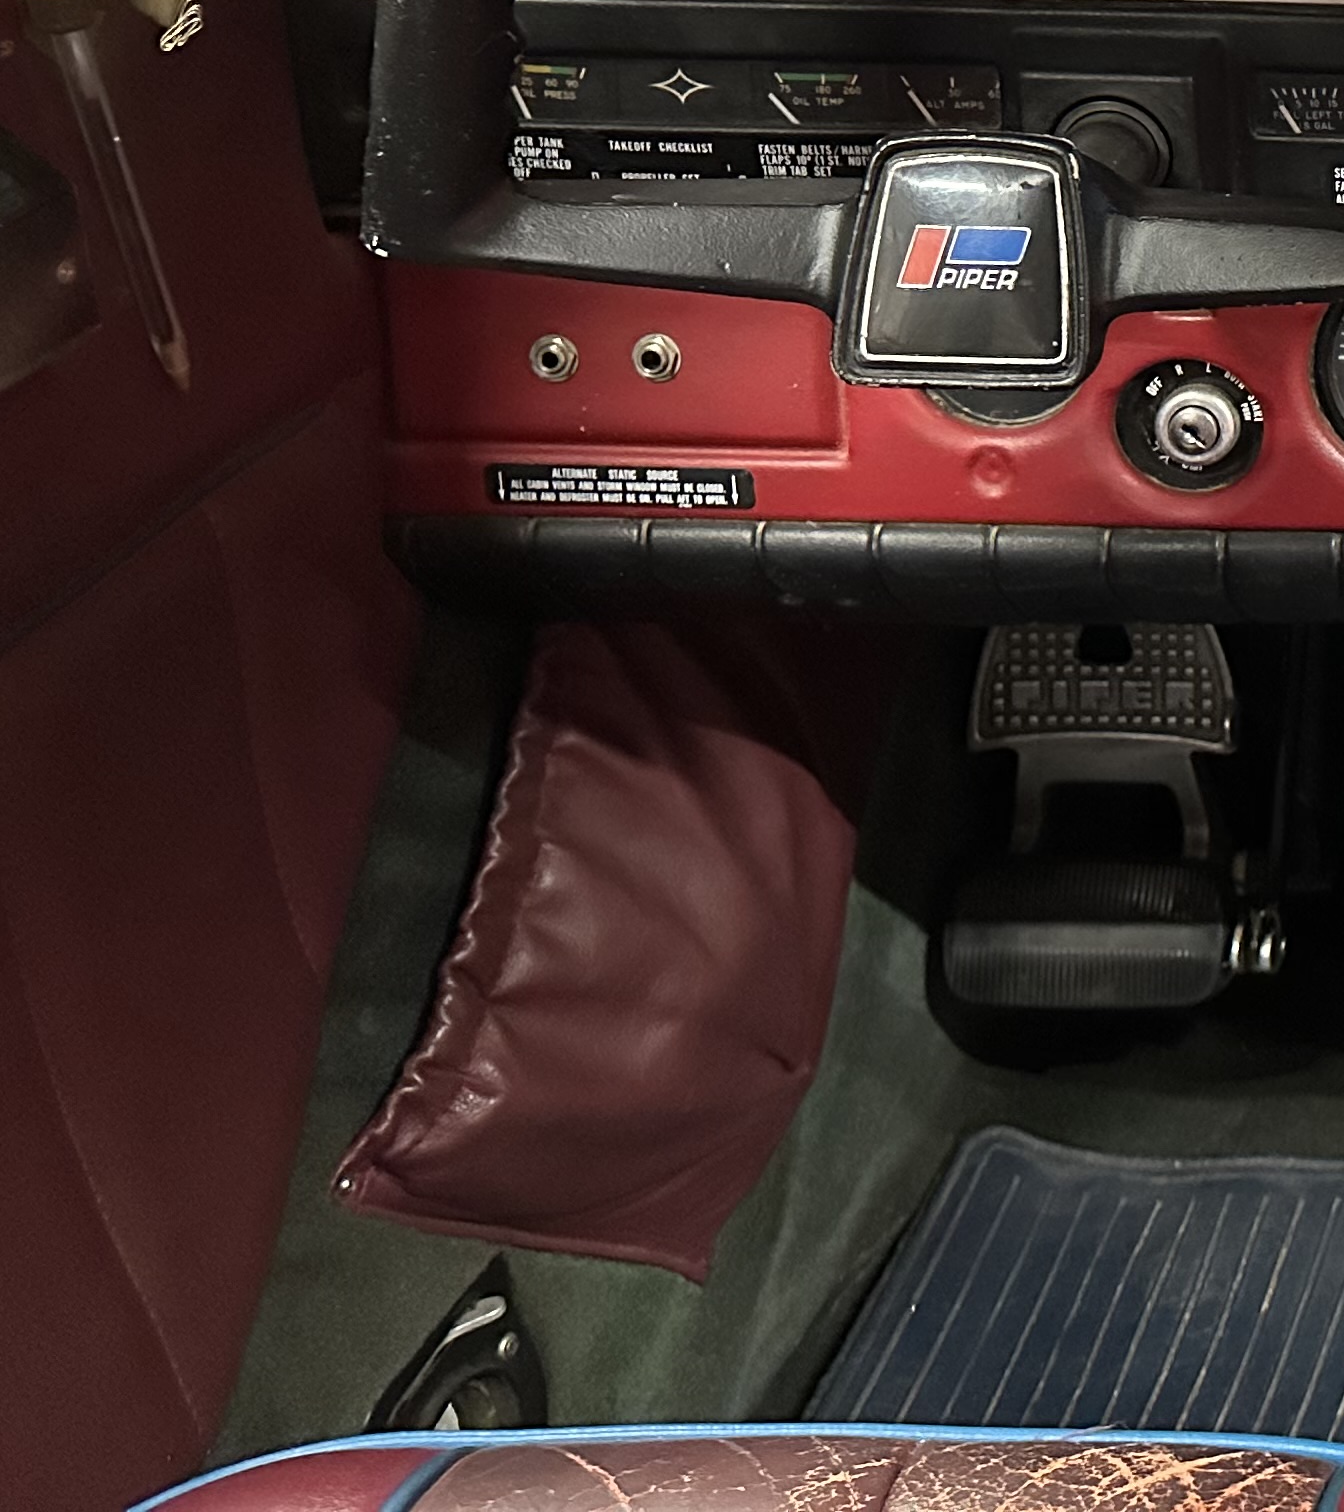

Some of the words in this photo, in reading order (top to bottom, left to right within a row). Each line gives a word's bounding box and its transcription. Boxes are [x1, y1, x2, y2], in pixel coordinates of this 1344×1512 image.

[608, 140, 651, 152] TAKEOFF
[659, 142, 712, 153] CHECKLIST
[763, 166, 786, 176] TRIM
[790, 167, 807, 176] TAB
[814, 167, 831, 176] SET
[937, 268, 1019, 290] PIPER
[552, 468, 597, 479] ALTERNATE
[608, 469, 636, 480] STATIC
[646, 470, 678, 481] SOURCE
